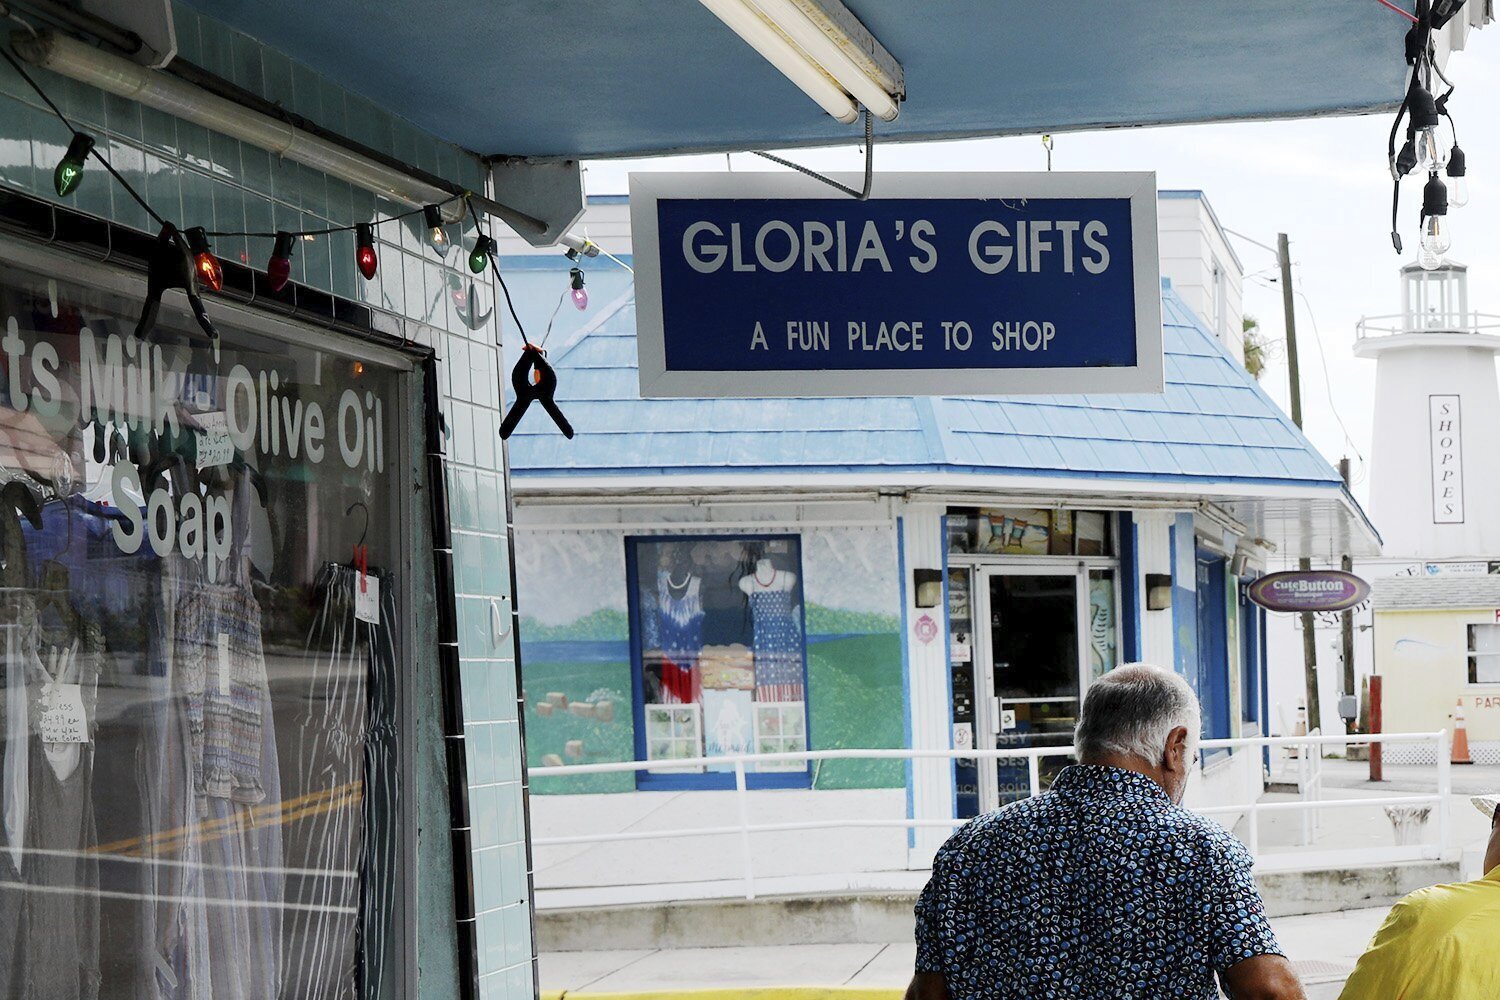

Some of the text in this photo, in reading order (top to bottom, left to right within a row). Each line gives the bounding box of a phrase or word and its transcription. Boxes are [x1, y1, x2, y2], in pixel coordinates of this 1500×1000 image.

[682, 219, 1111, 274] GLORIA'S GIFTS
[750, 320, 1056, 352] A FUN PLACE TO SHOP
[79, 327, 181, 439] Milk
[226, 364, 326, 464] Olive
[338, 389, 384, 474] Oil
[1439, 402, 1455, 516] SHOPPES
[111, 459, 233, 584] Soap
[1299, 580, 1345, 592] Button
